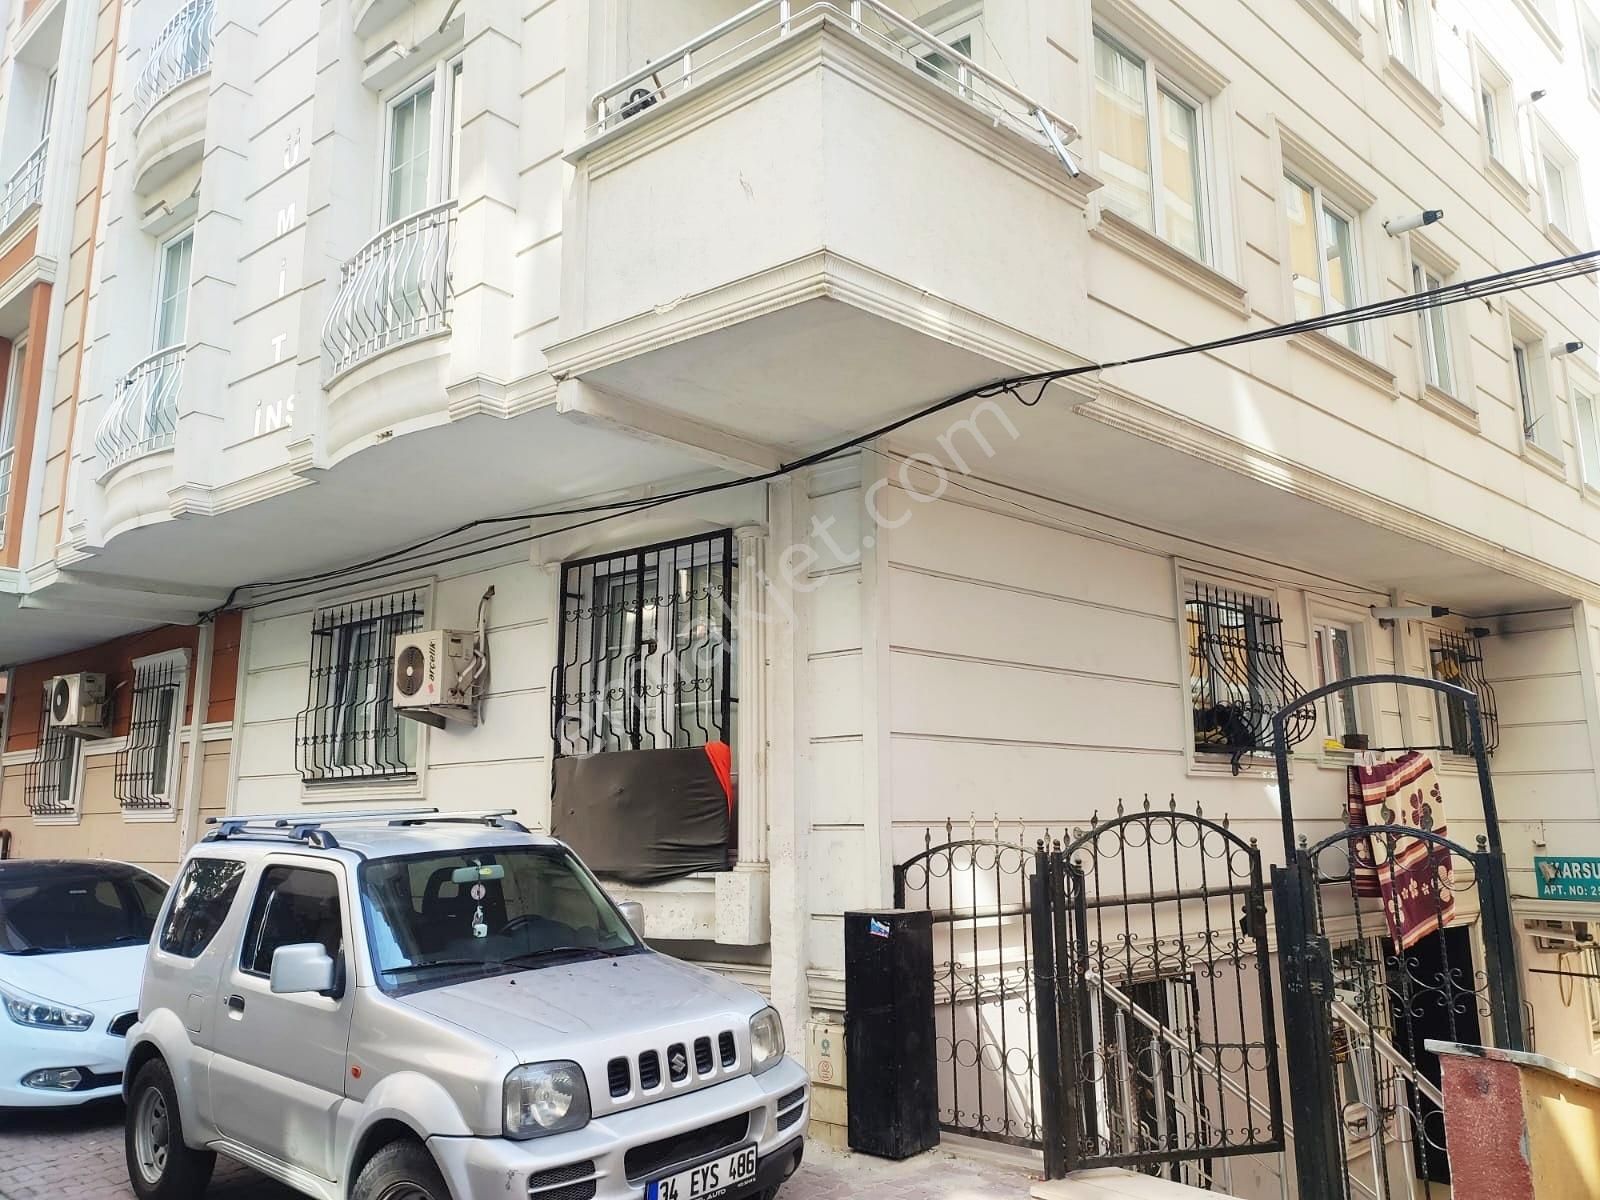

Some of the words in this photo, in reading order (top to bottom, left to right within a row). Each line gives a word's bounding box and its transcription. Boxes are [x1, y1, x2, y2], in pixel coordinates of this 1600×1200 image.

[1544, 885, 1566, 895] APT.
[1569, 885, 1588, 896] NO:
[690, 1163, 719, 1196] EYS
[729, 1149, 755, 1180] 486
